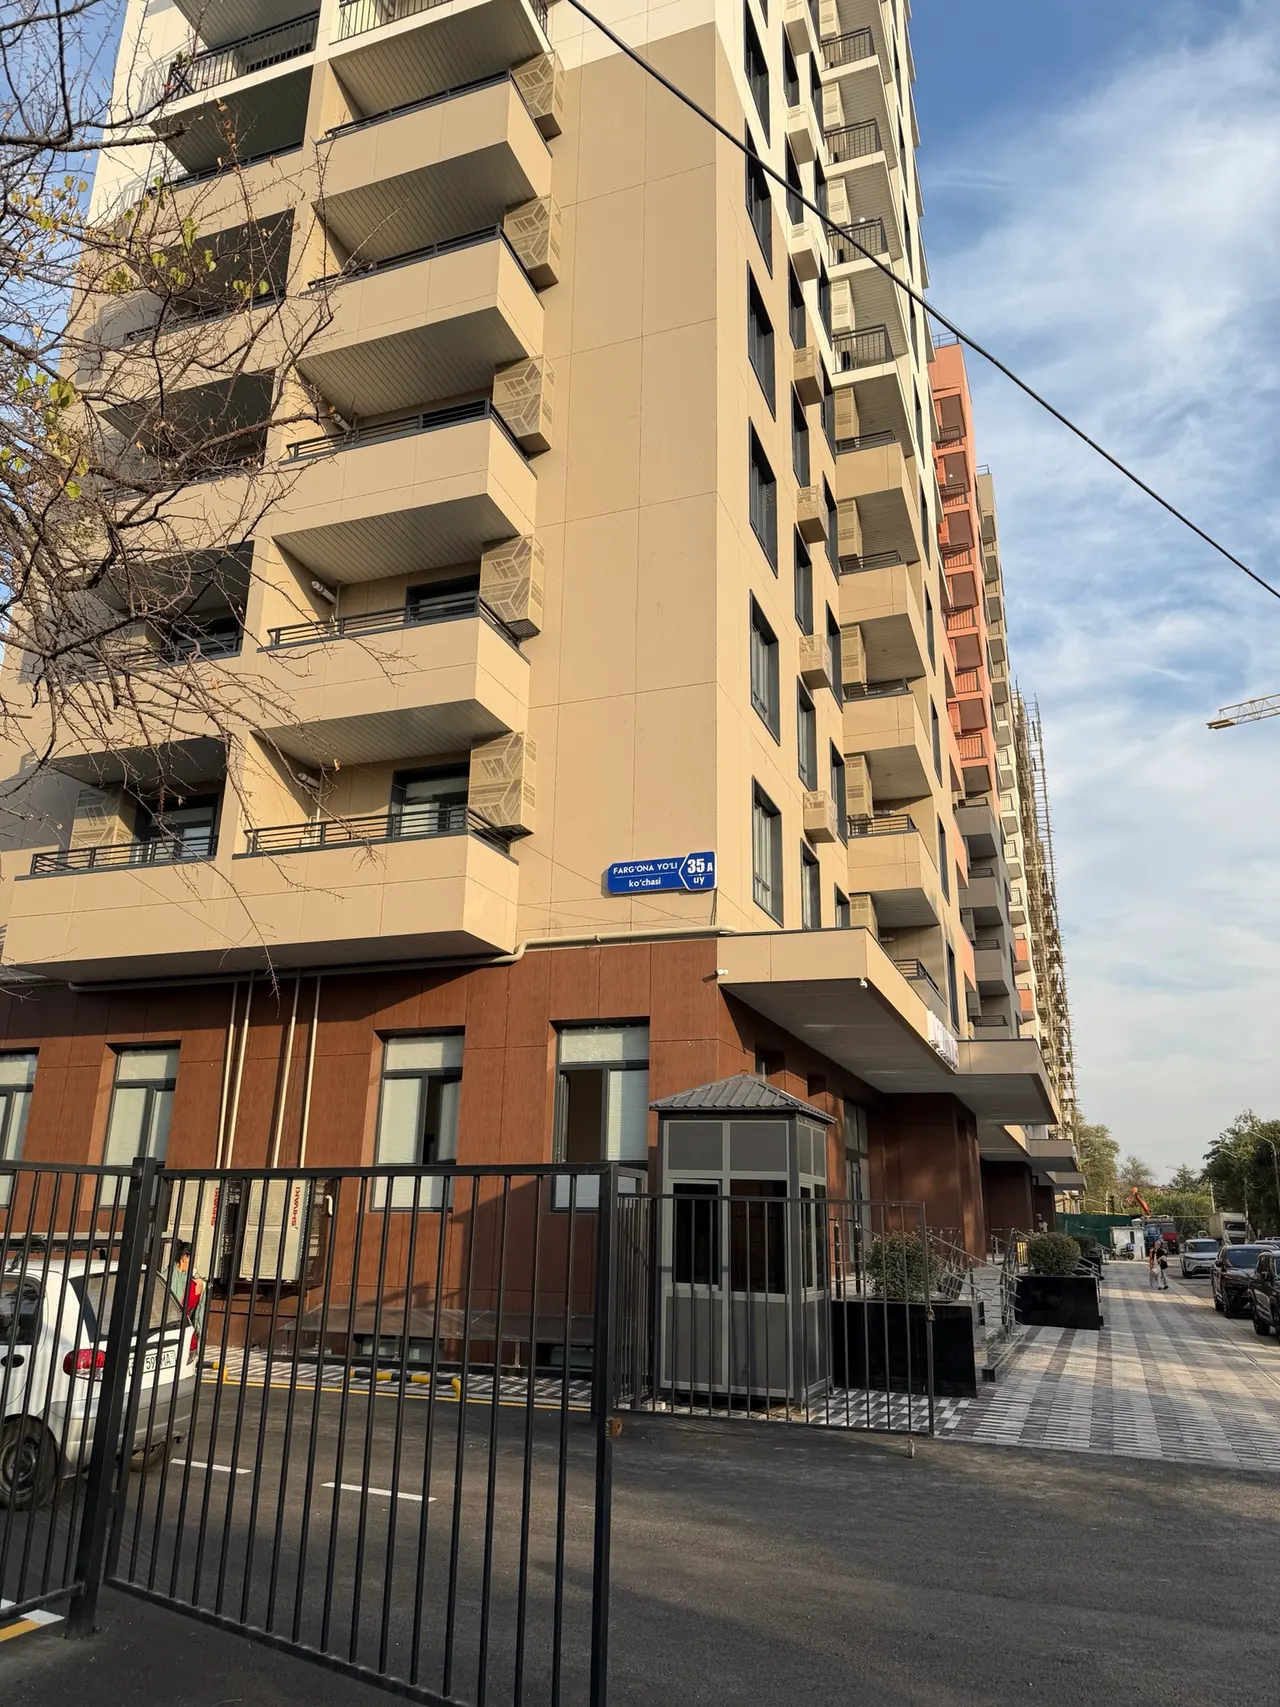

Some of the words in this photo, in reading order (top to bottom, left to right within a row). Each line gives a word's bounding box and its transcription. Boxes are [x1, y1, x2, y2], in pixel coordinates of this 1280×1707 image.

[687, 858, 705, 874] 35
[706, 862, 714, 872] A
[693, 876, 705, 886] uy
[291, 1186, 301, 1228] SHIVAKI
